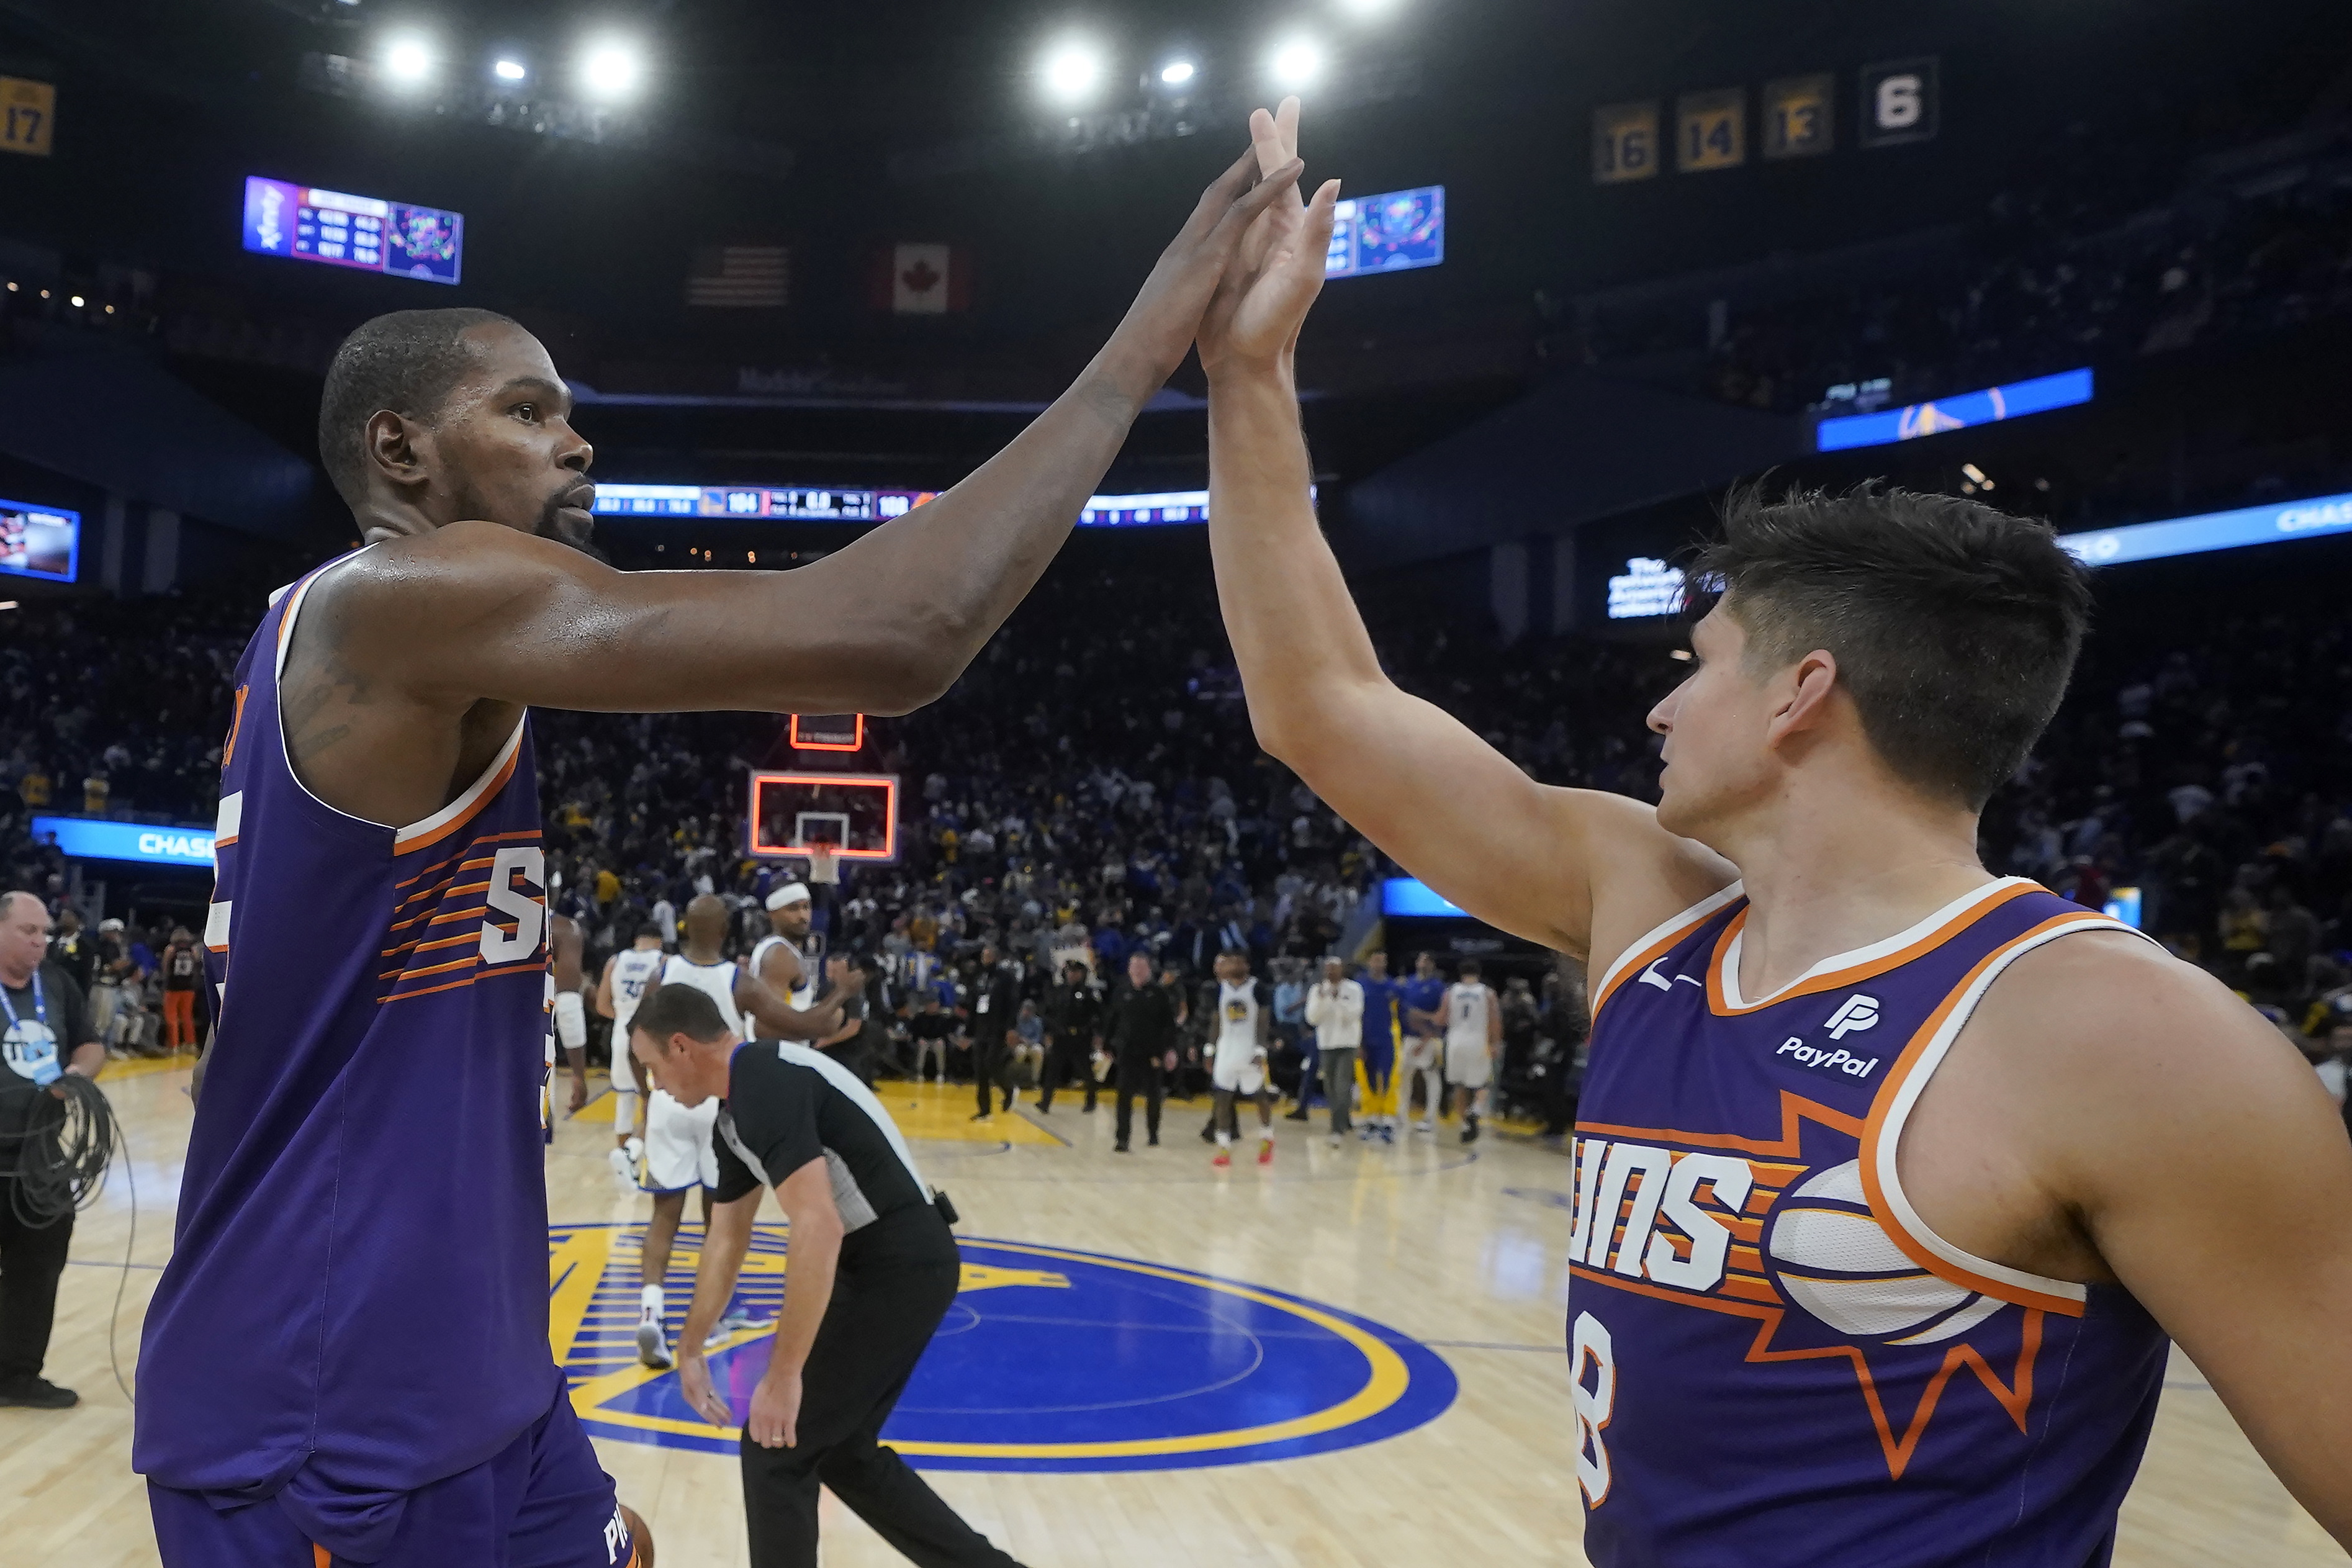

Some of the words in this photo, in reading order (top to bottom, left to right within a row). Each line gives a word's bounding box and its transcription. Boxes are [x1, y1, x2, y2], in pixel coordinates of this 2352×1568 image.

[1876, 73, 1924, 129] 6
[6, 107, 42, 143] 17
[1689, 120, 1731, 159] 14
[1774, 104, 1821, 148] 13
[1604, 129, 1647, 173] 16
[479, 847, 552, 964] S
[1775, 1035, 1880, 1079] PayPal
[1570, 1310, 1617, 1510] 8
